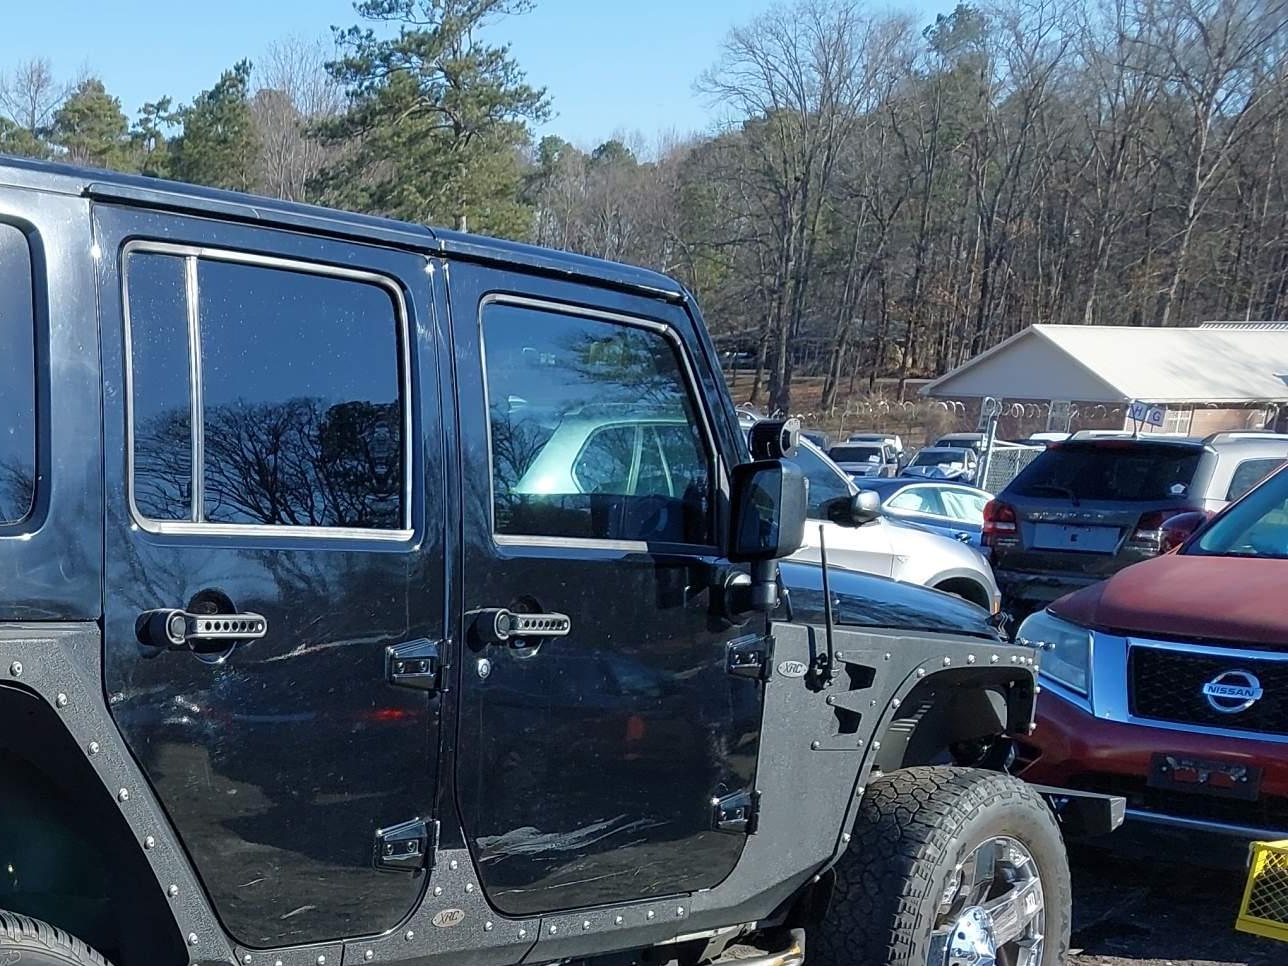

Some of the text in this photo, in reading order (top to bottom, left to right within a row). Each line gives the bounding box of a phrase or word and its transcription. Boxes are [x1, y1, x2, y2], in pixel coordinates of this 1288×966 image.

[1153, 411, 1161, 421] G
[783, 663, 802, 673] XRC
[1208, 686, 1255, 697] NISSAN
[438, 911, 459, 924] XRC
